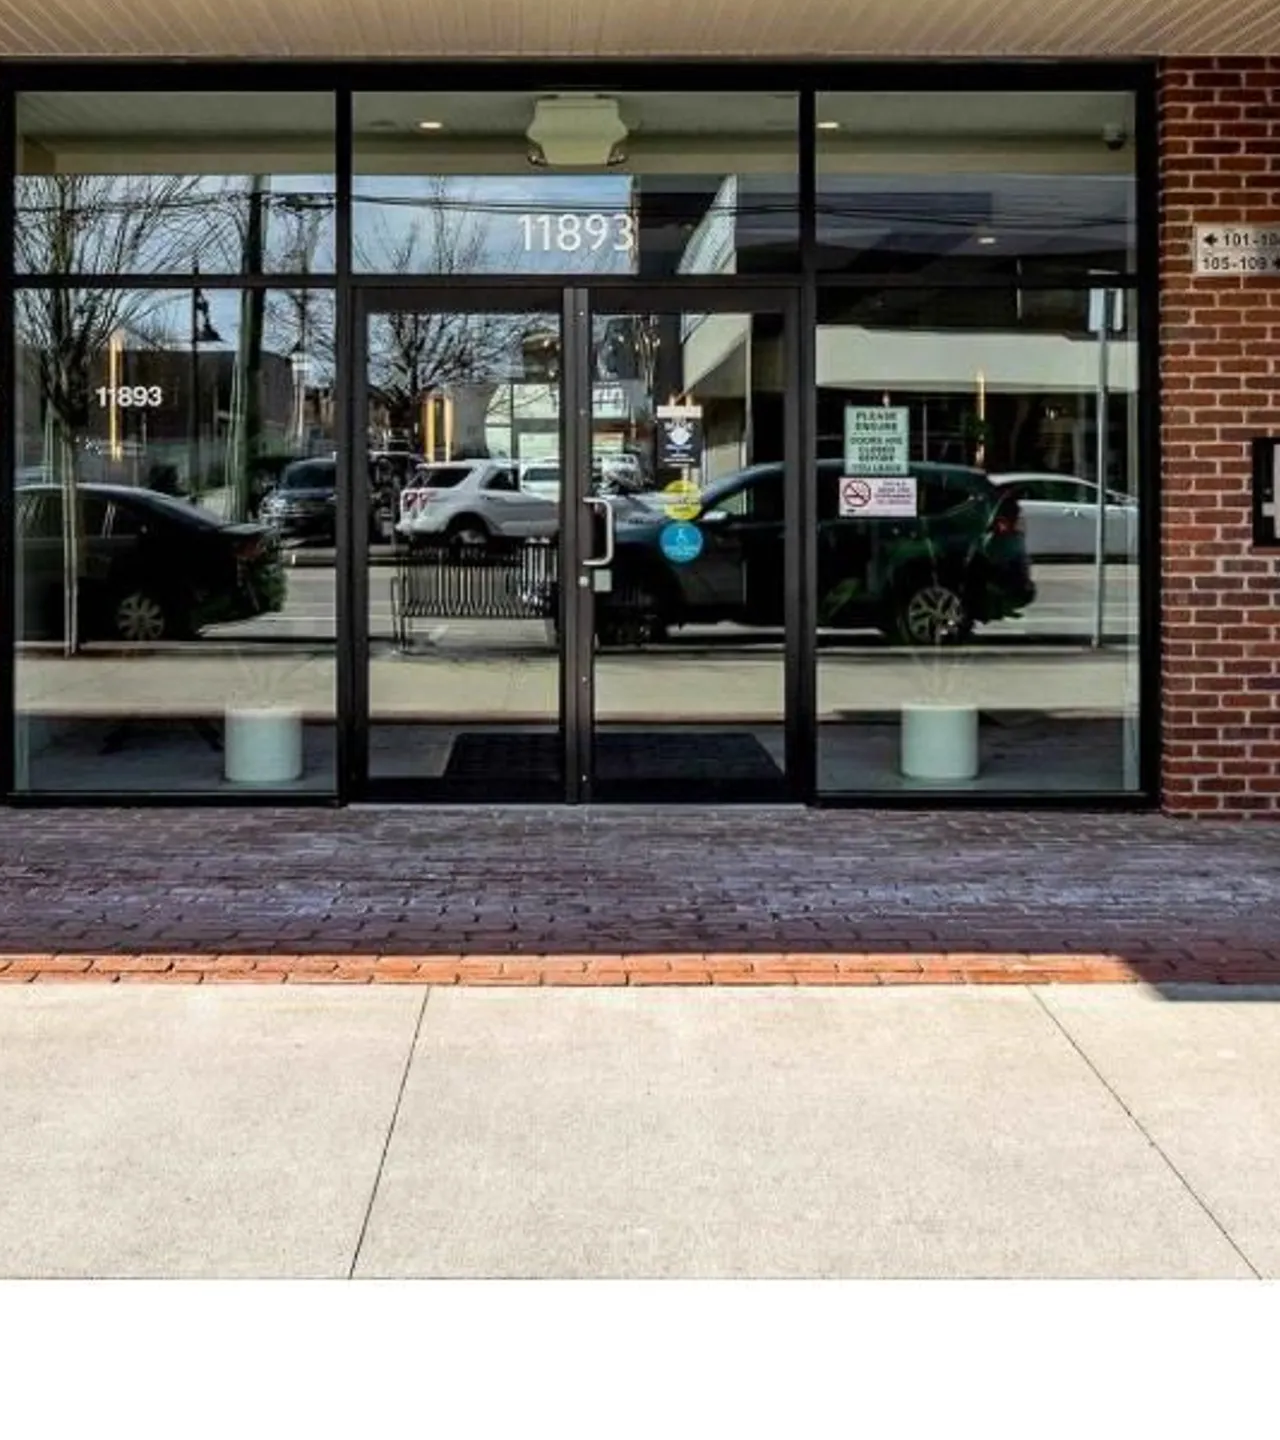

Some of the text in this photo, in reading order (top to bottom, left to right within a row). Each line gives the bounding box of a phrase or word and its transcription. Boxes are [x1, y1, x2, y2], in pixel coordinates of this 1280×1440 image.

[518, 213, 634, 251] 11893
[95, 386, 162, 408] 11893
[856, 412, 897, 421] PLEASE
